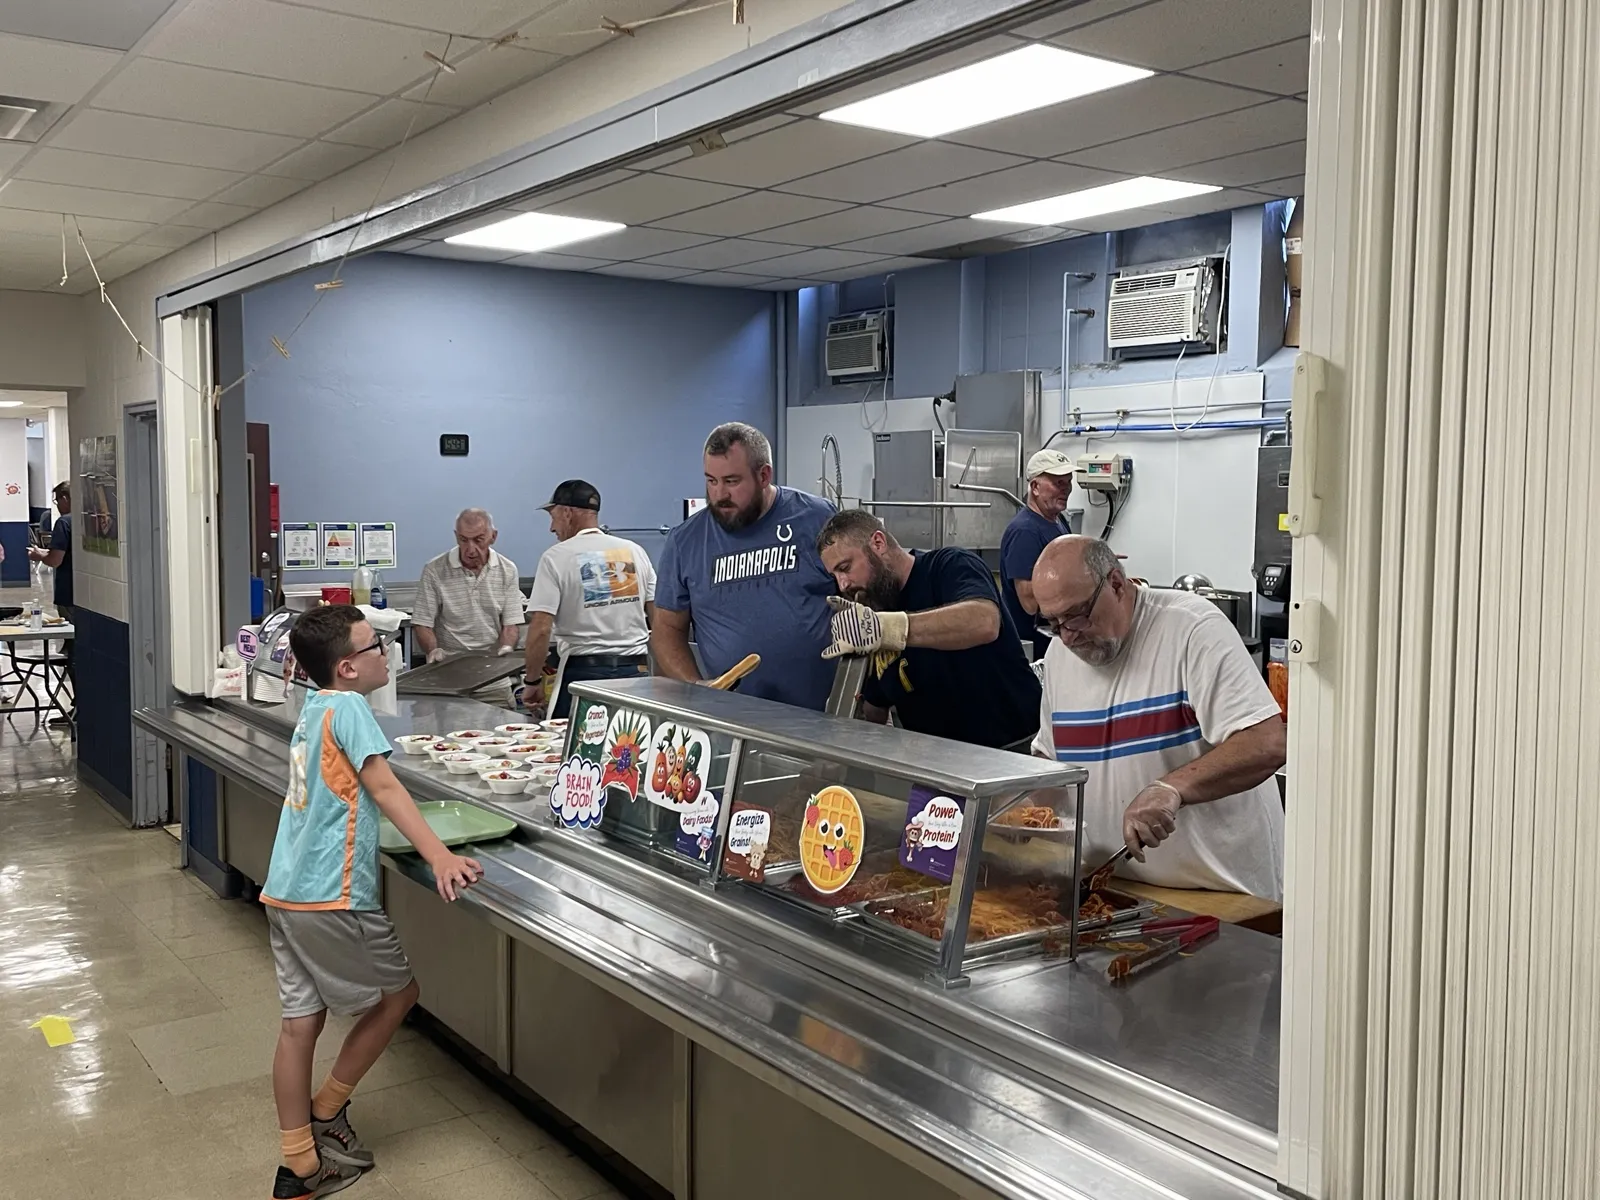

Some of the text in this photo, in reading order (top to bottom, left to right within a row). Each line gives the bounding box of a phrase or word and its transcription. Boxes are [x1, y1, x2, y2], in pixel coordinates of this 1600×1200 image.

[714, 545, 797, 584] INDIANAPOLIS
[584, 596, 640, 609] UNDER ARMOUR
[240, 634, 251, 643] BEST
[588, 710, 605, 720] Crunch
[566, 773, 592, 792] BRAIN
[566, 790, 594, 808] FOOD!
[928, 803, 959, 819] Power
[683, 814, 714, 828] Dairy Foods!
[736, 813, 765, 828] Energize
[730, 837, 751, 848] Grains!
[922, 829, 955, 843] Protein!
